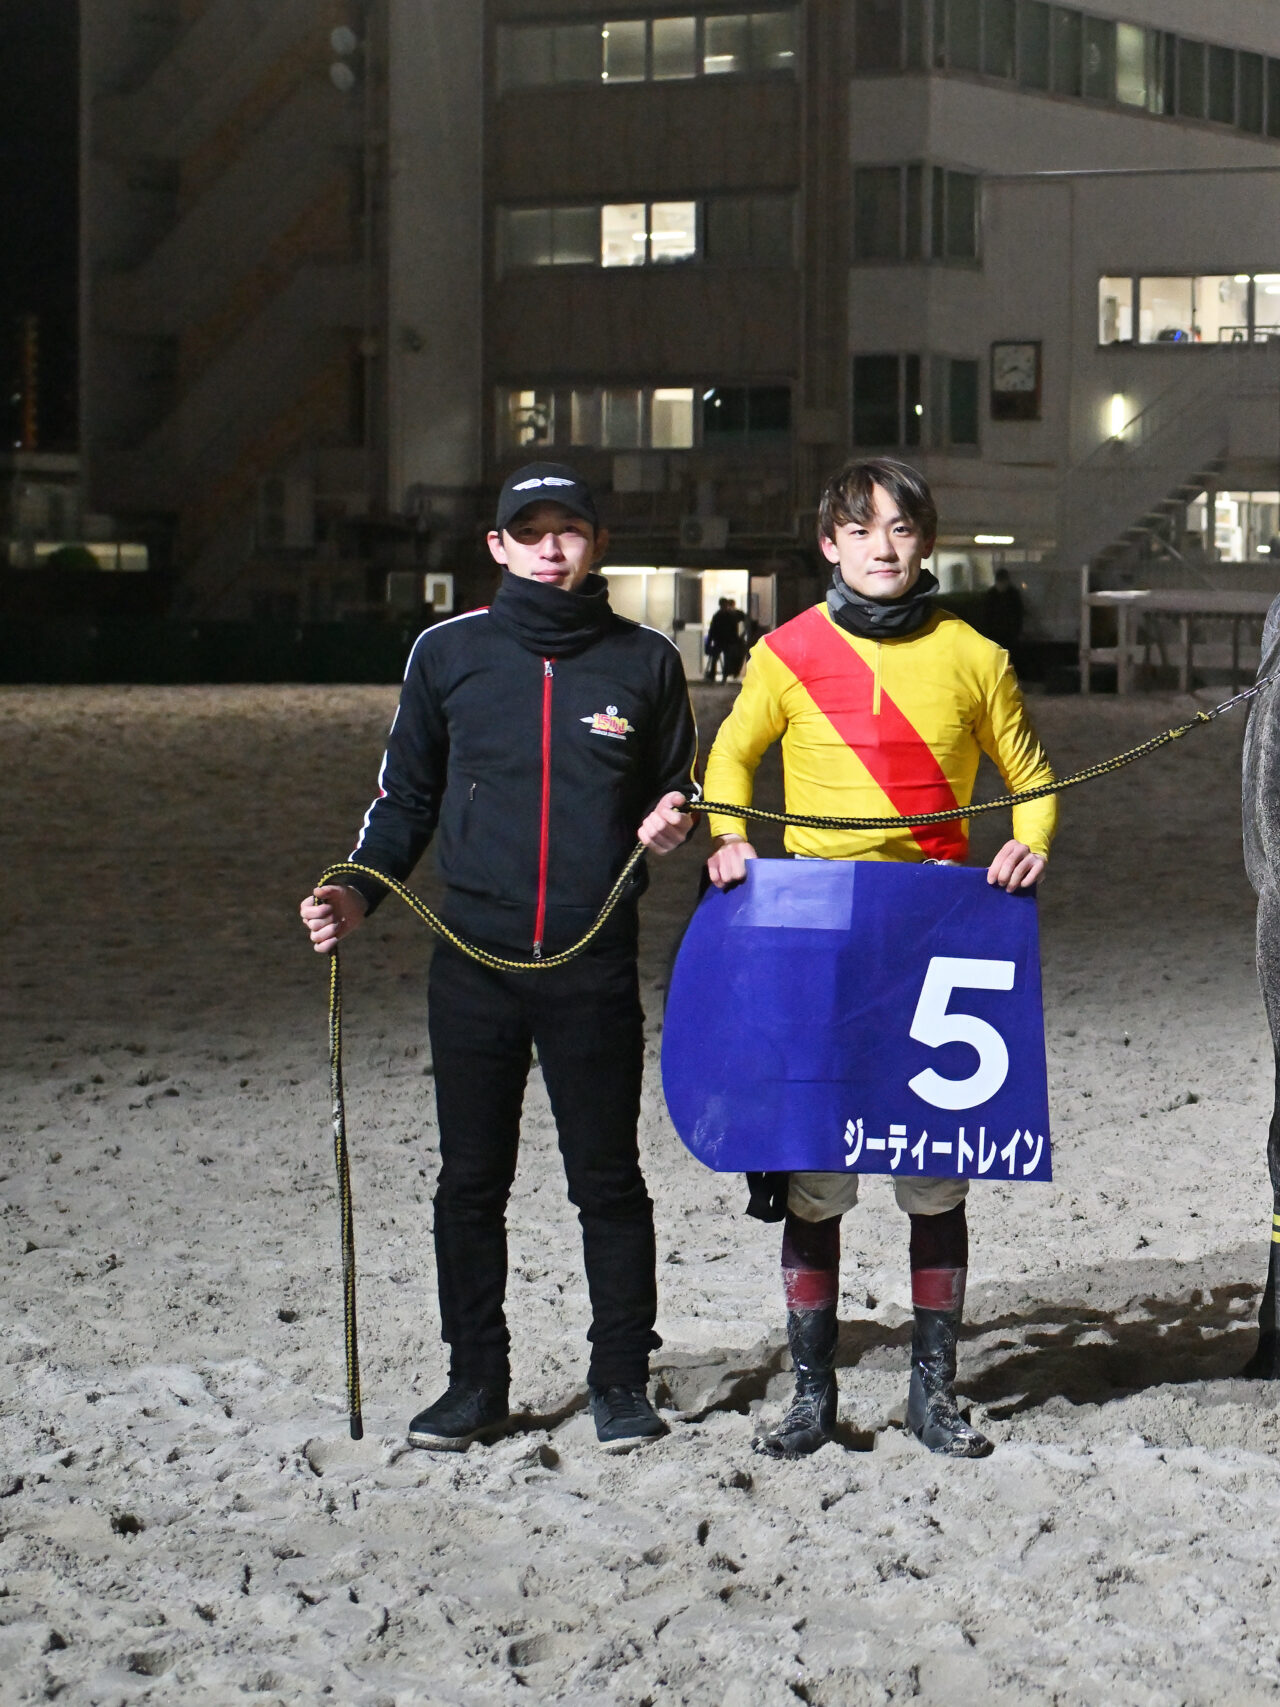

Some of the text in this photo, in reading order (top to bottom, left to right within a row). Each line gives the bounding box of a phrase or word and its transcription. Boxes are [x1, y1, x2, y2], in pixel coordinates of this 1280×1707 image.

[907, 956, 1016, 1111] 5
[844, 1117, 1044, 1176] ジーティートレイン
